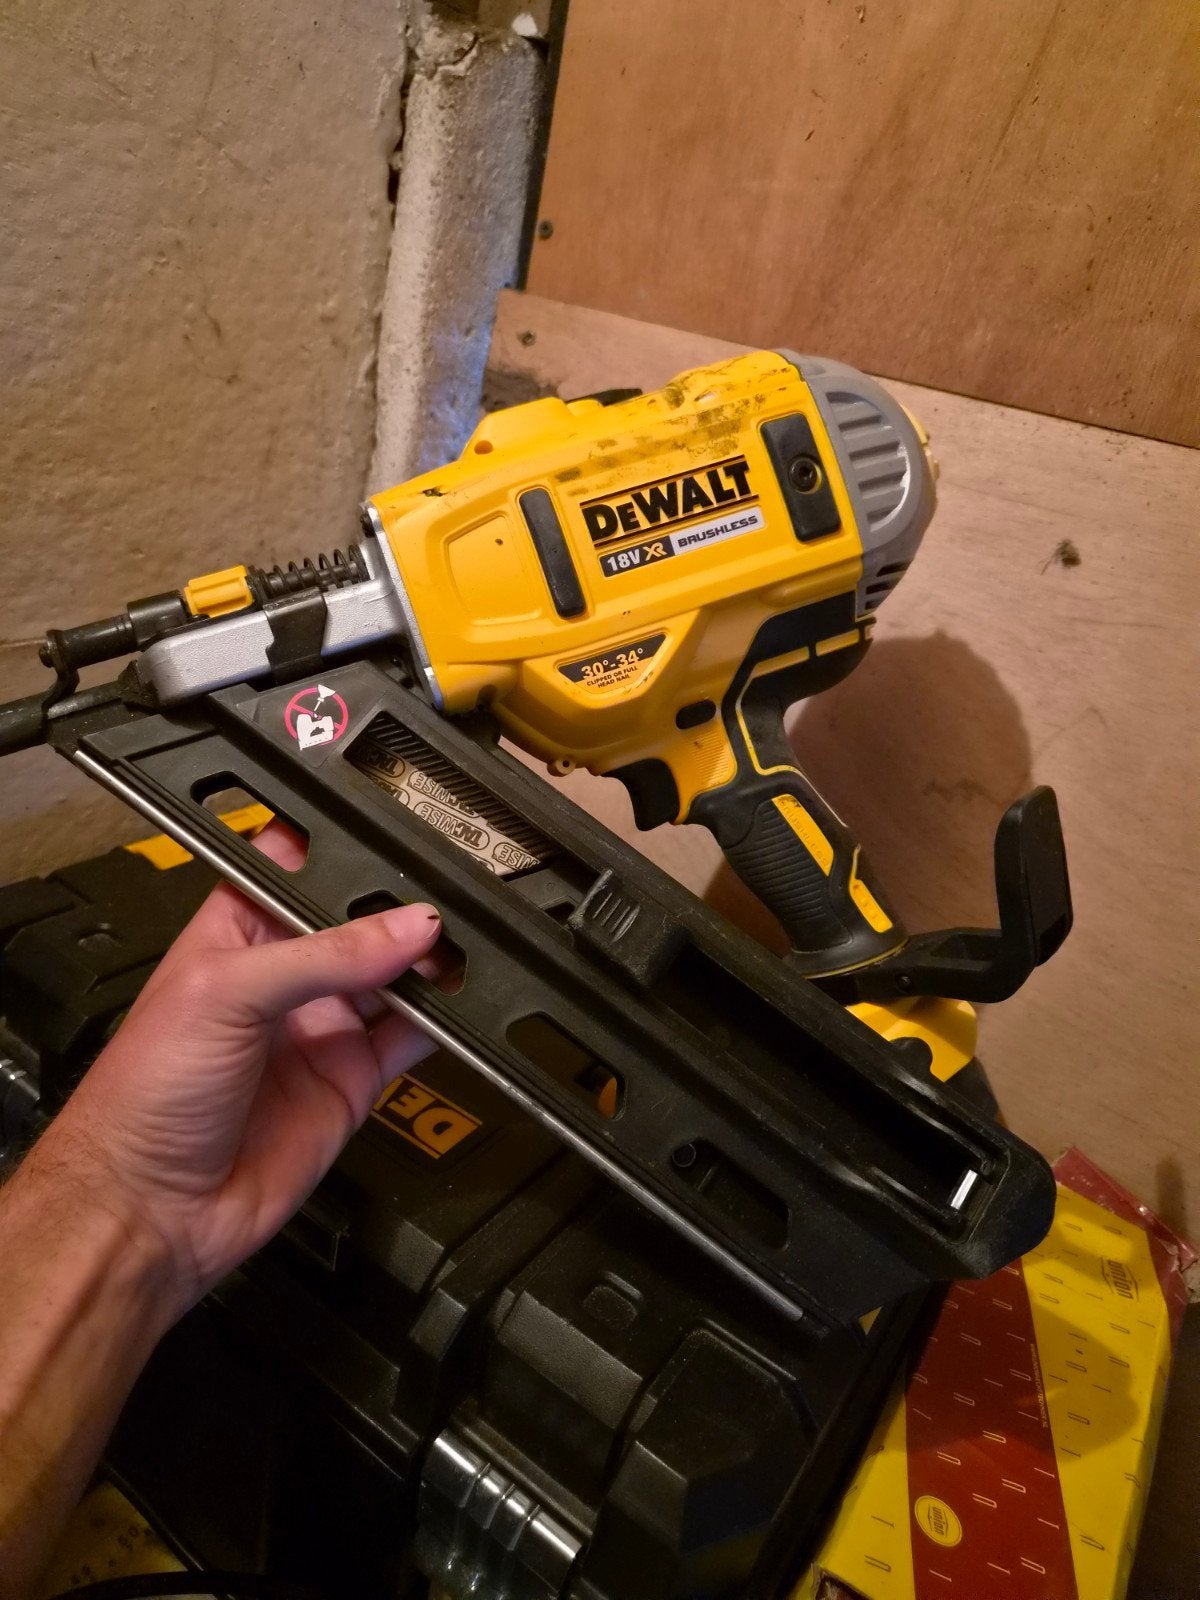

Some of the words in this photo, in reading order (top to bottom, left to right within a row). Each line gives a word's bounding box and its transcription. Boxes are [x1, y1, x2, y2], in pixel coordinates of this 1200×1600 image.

[607, 549, 641, 572] 18V
[642, 541, 668, 562] XR
[677, 515, 759, 548] BRUSHLESS
[586, 674, 612, 687] CLIPPED
[613, 670, 623, 678] OR
[623, 666, 638, 674] FULL
[597, 679, 615, 688] HEAD
[616, 674, 631, 683] NAIL
[420, 804, 483, 848] TACWISE
